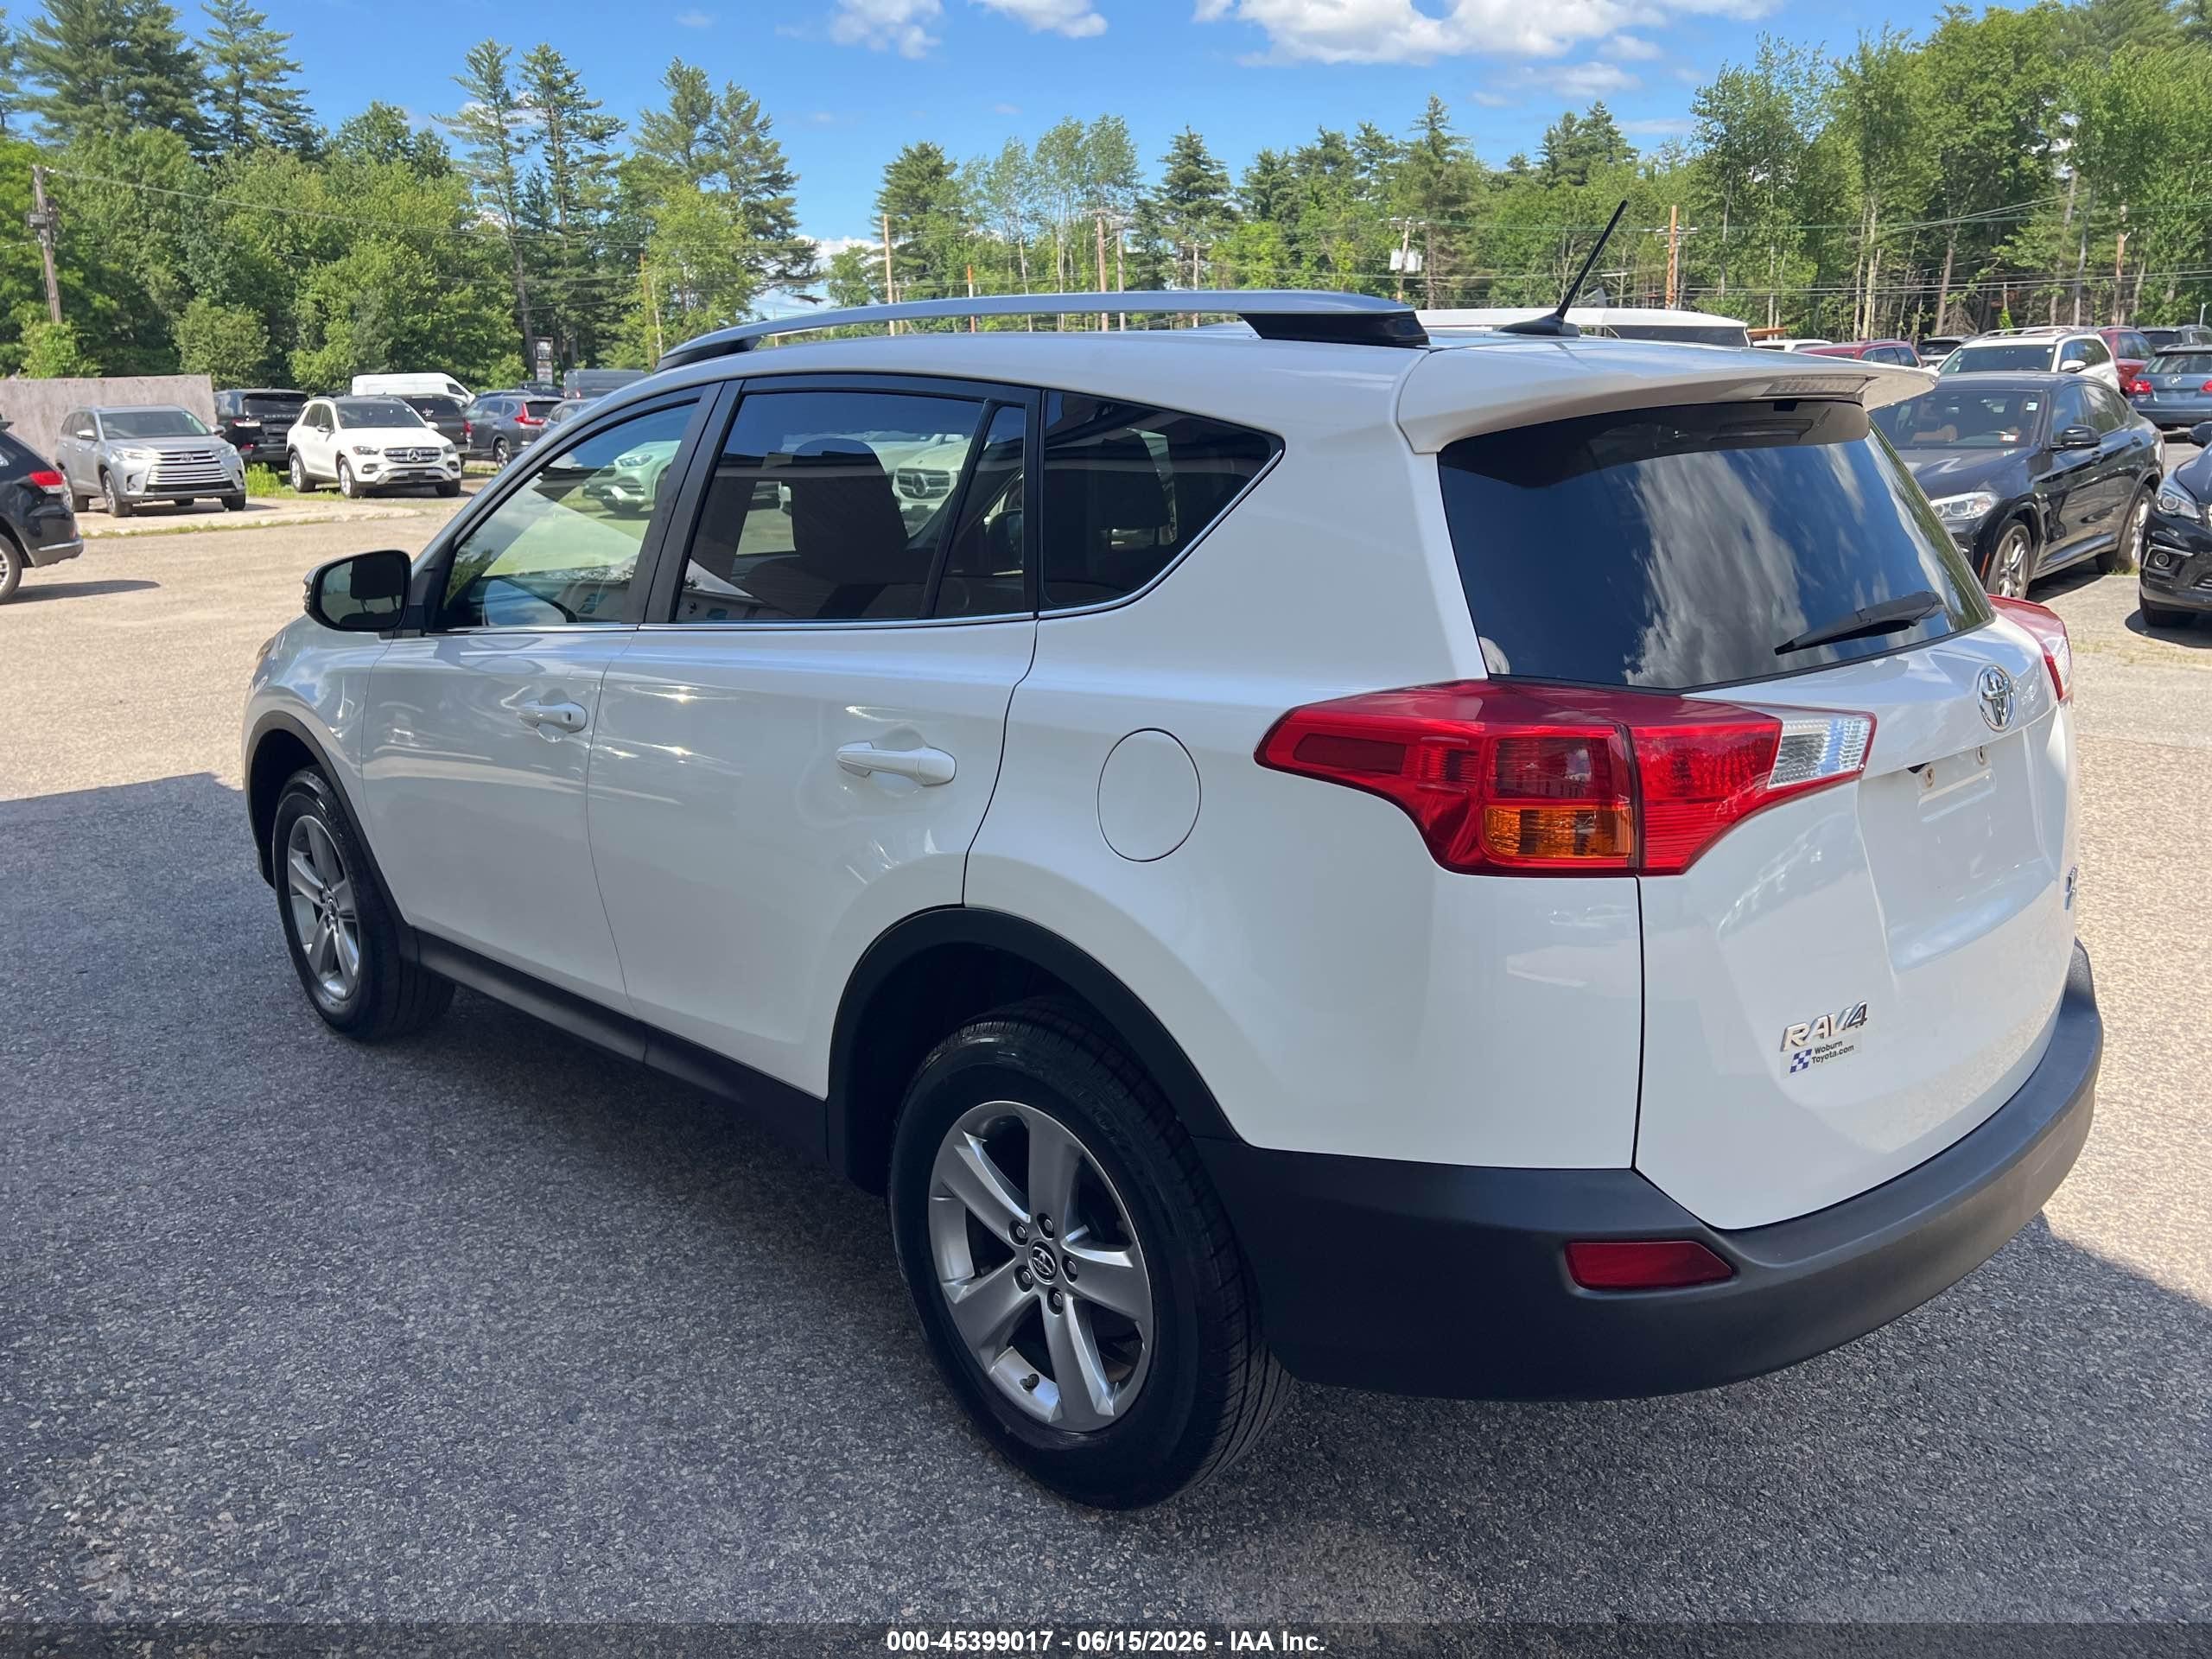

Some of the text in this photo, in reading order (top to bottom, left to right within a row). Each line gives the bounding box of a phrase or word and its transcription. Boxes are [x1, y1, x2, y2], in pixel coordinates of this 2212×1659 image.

[1780, 1001, 1868, 1052] RAV4
[1811, 1045, 1855, 1065] Toyota.com
[1815, 1040, 1843, 1055] Woburn
